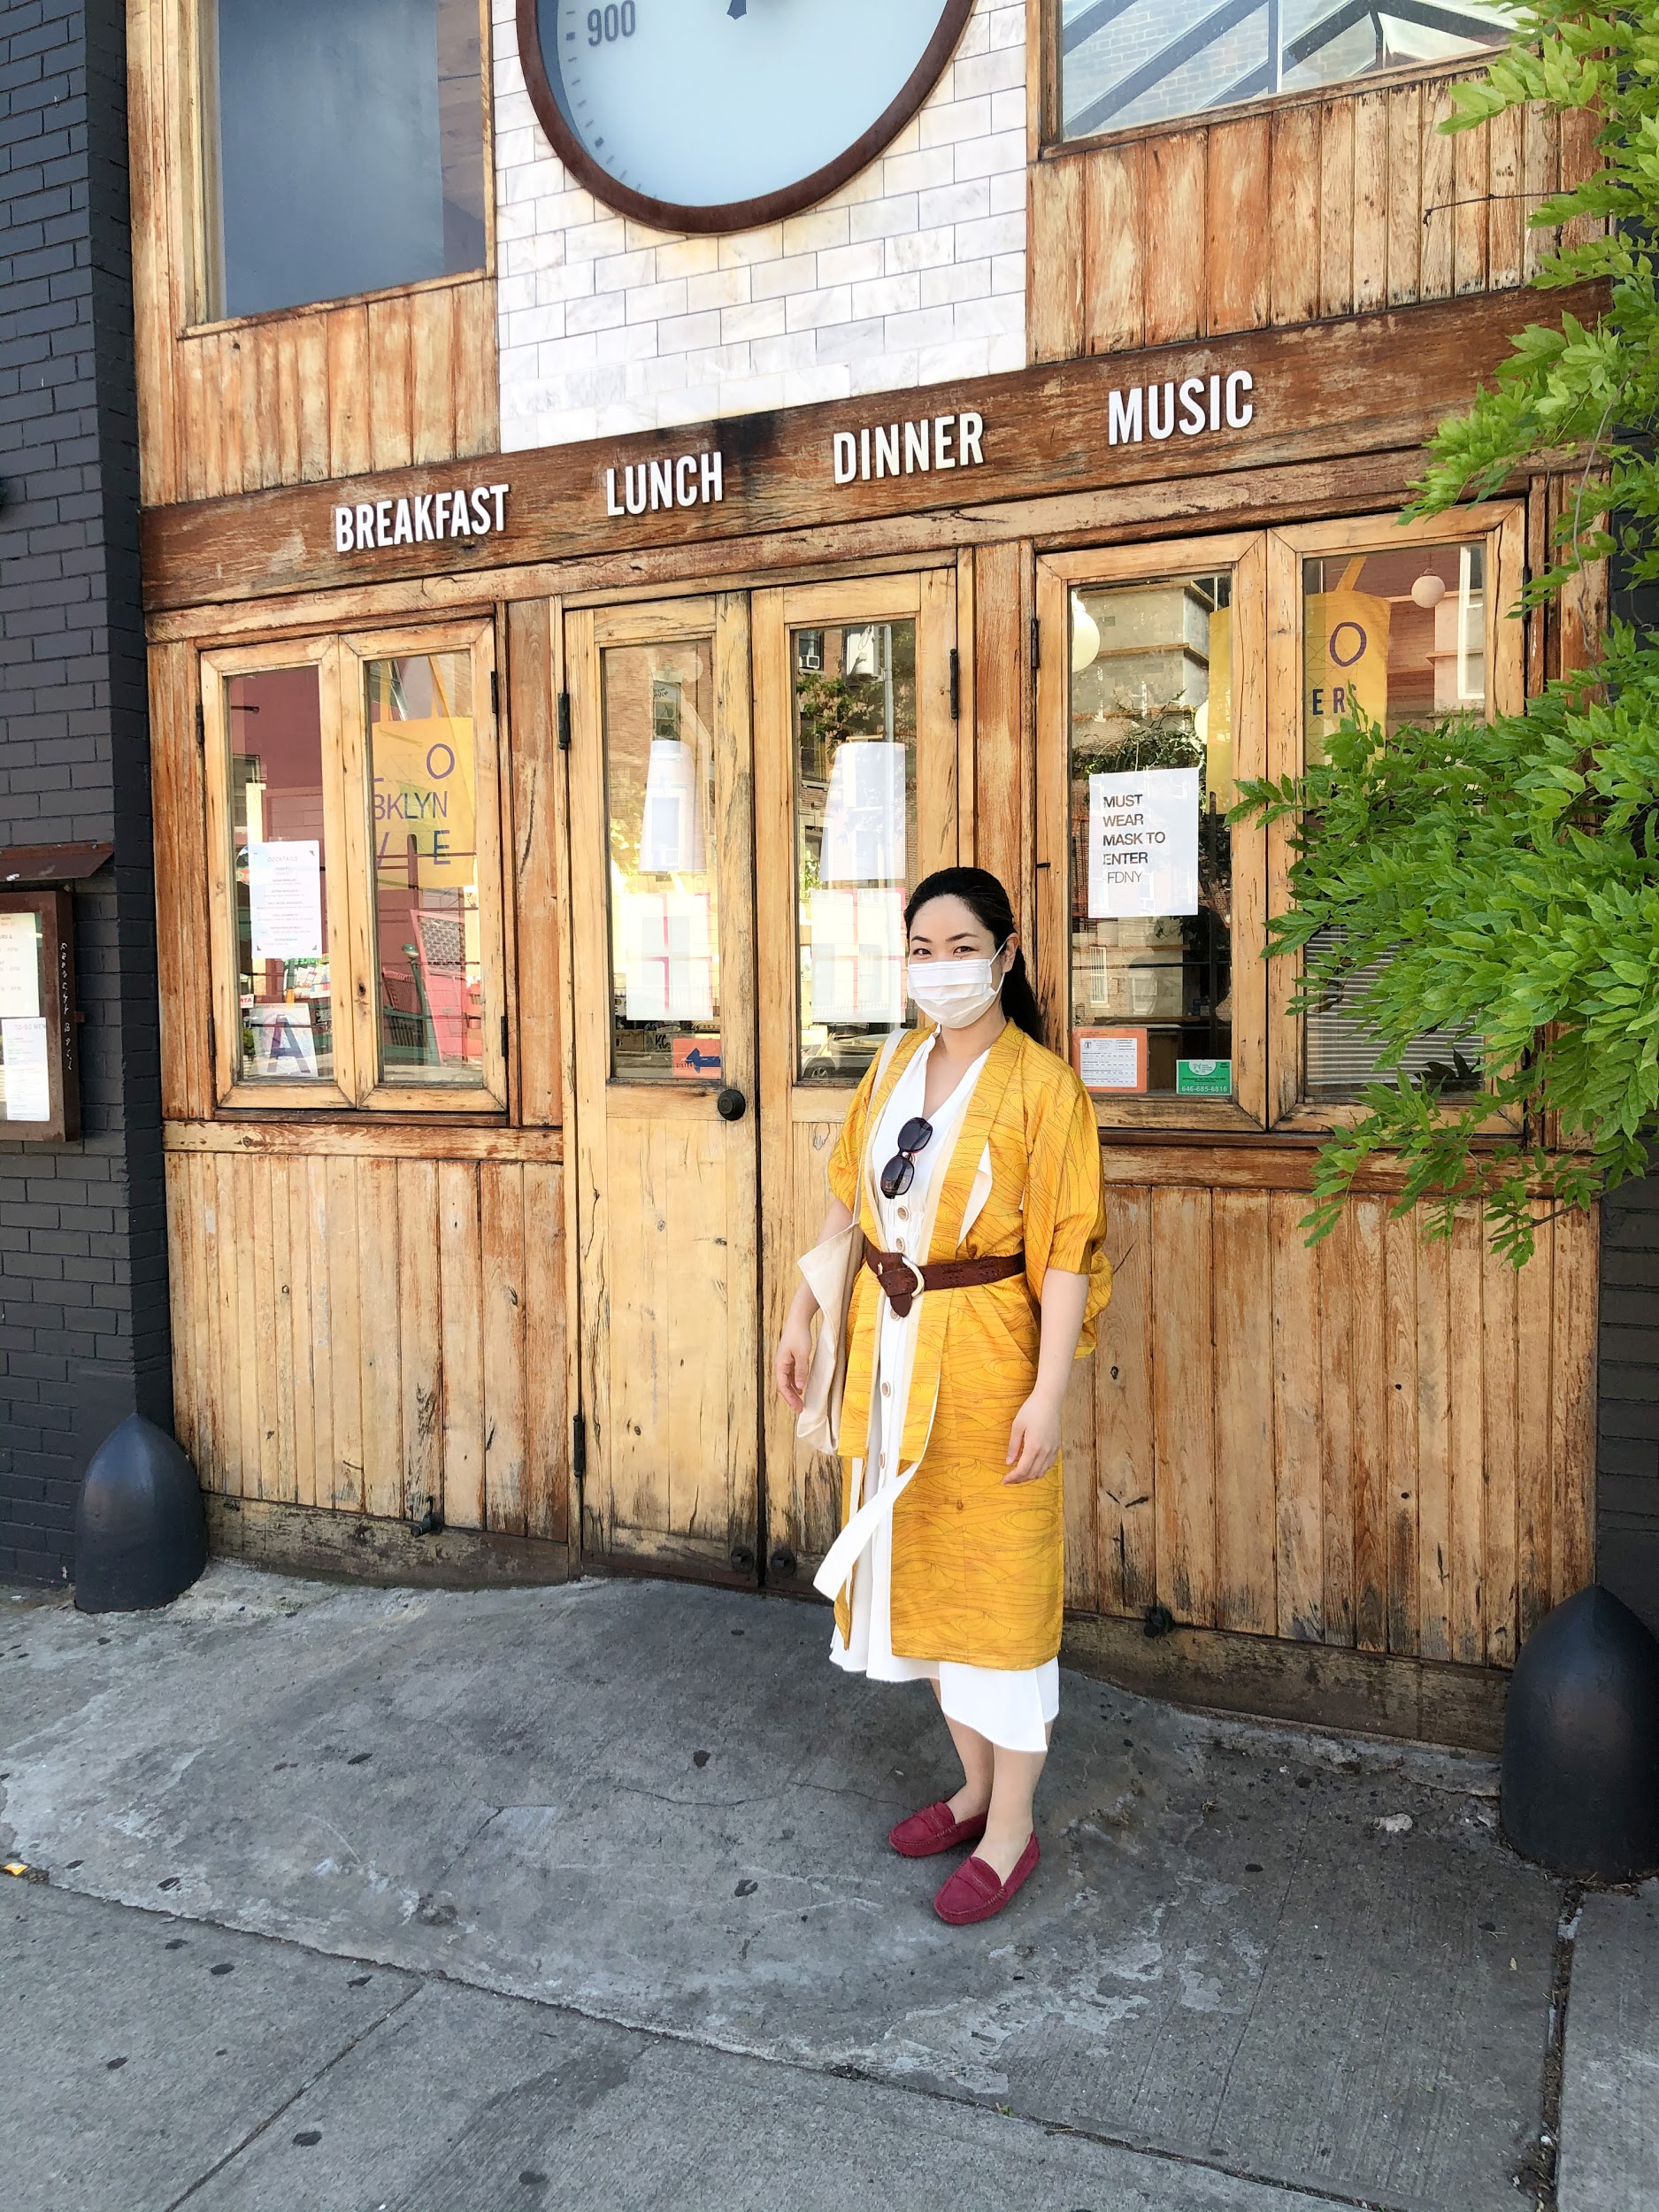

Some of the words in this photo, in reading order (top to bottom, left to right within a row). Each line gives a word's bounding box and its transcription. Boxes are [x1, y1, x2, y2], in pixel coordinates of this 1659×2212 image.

[588, 0, 636, 46] 900
[335, 484, 510, 553] BREAKFAST
[606, 451, 723, 516] LUNCH
[833, 411, 985, 485] DINNER
[1108, 370, 1254, 446] MUSIC
[1312, 684, 1357, 716] ER
[373, 791, 448, 820] BKLYN
[1102, 795, 1143, 809] MUST
[1102, 813, 1144, 827] WEAR
[1102, 833, 1144, 847] MASK
[1146, 831, 1166, 844] TO
[1102, 851, 1148, 865] ENTER
[266, 1014, 311, 1073] A
